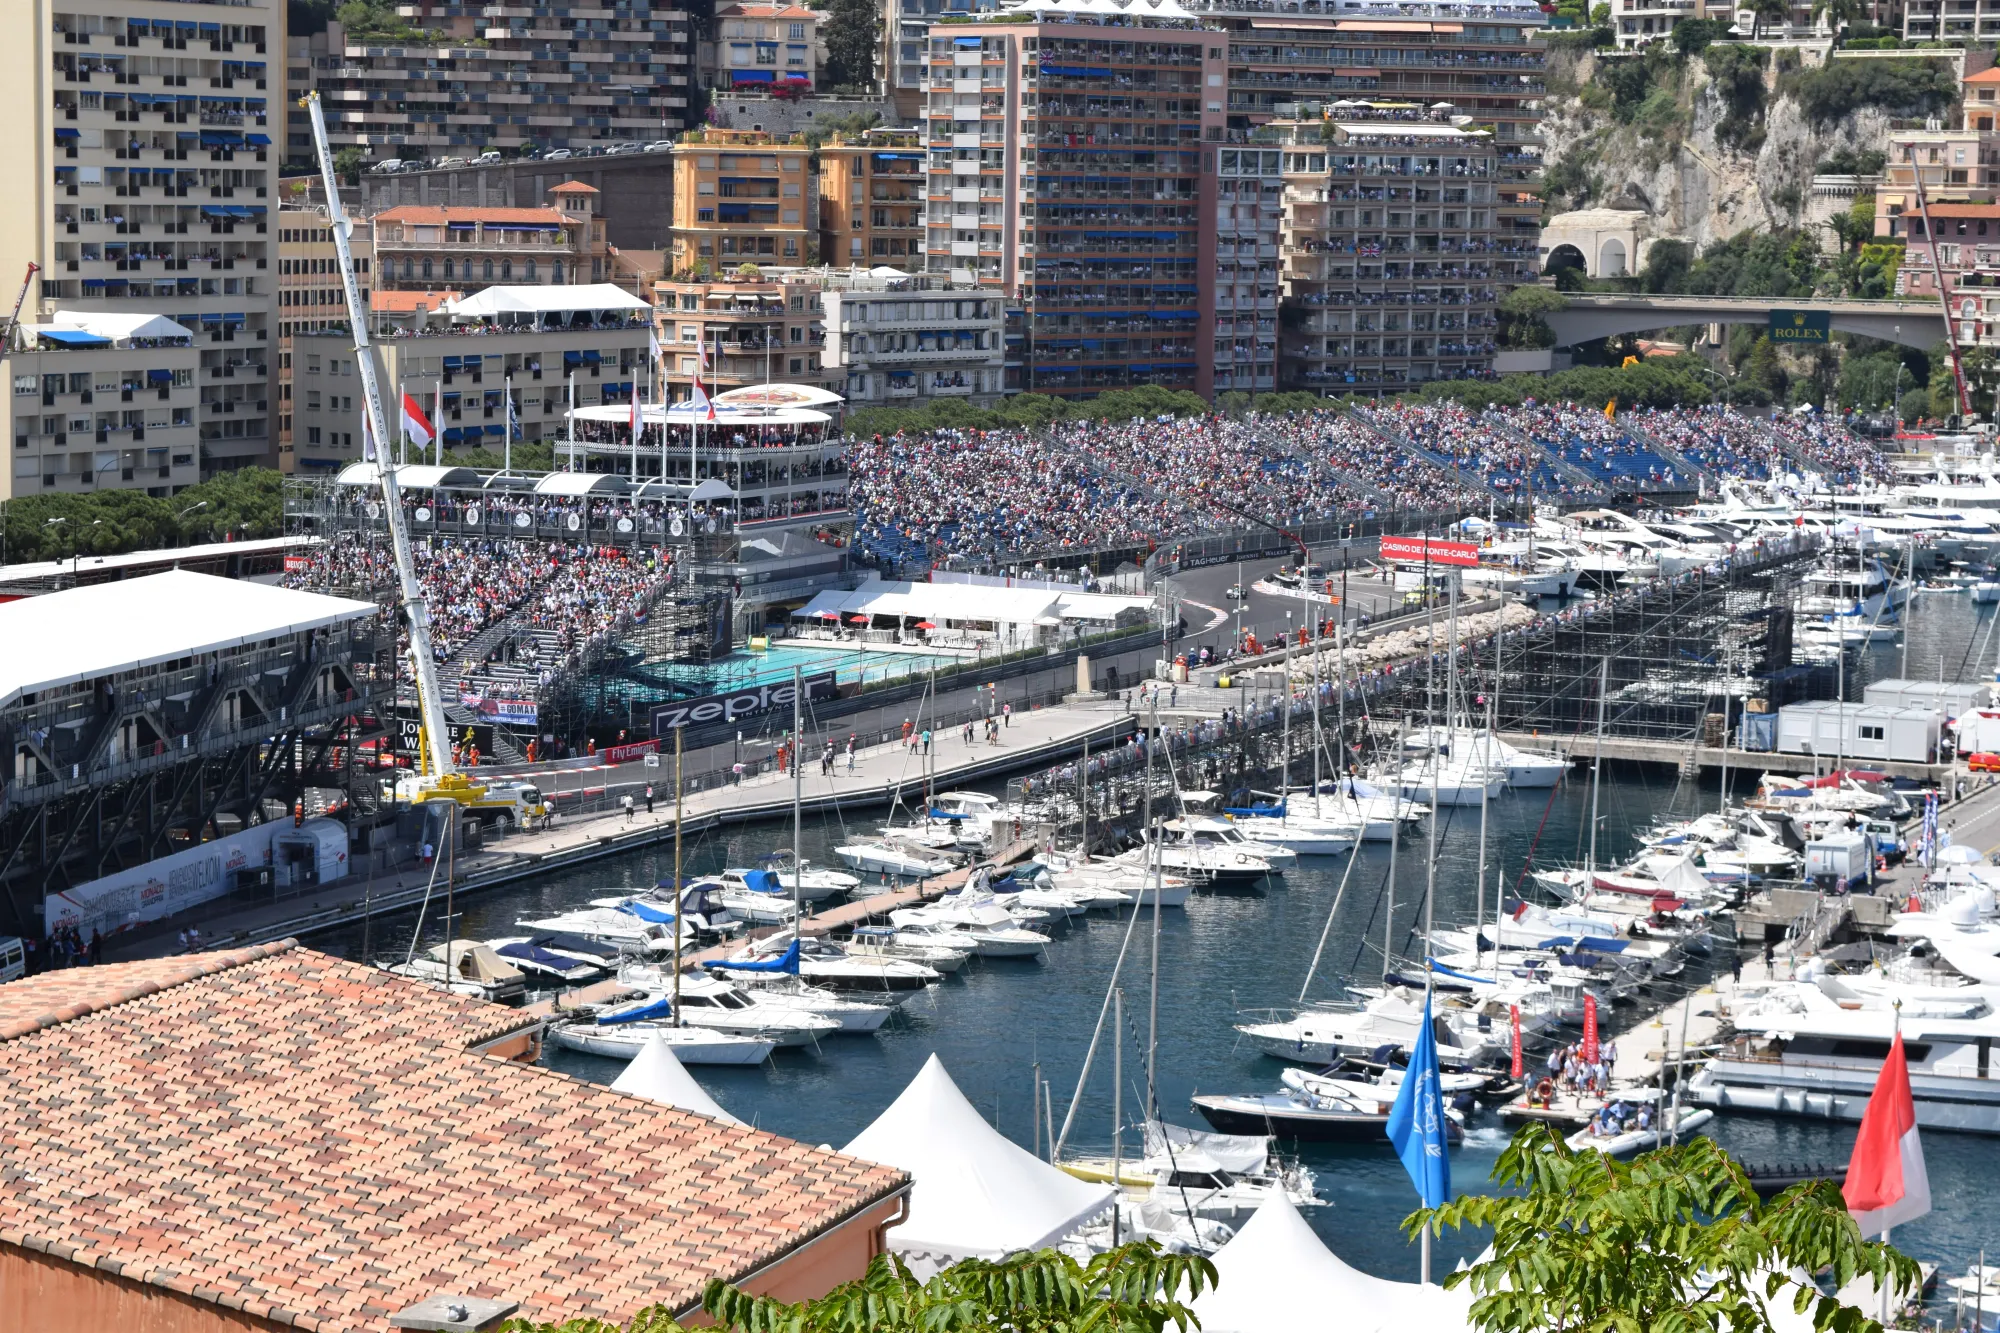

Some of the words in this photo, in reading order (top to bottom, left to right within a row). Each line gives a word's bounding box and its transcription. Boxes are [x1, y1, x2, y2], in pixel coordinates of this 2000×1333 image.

[347, 268, 359, 309] Mediaco
[1774, 328, 1823, 339] ROLEX
[372, 394, 384, 435] Mediaco
[1382, 542, 1411, 552] CASINO
[1411, 545, 1421, 554] DE
[1423, 547, 1477, 559] MONTE-CARLO
[500, 704, 535, 715] #GOMAX
[656, 673, 832, 736] zepter
[741, 695, 832, 717] INTERNATONAL
[612, 748, 625, 760] Fly
[626, 743, 656, 757] Emirates
[141, 884, 165, 900] MONACO
